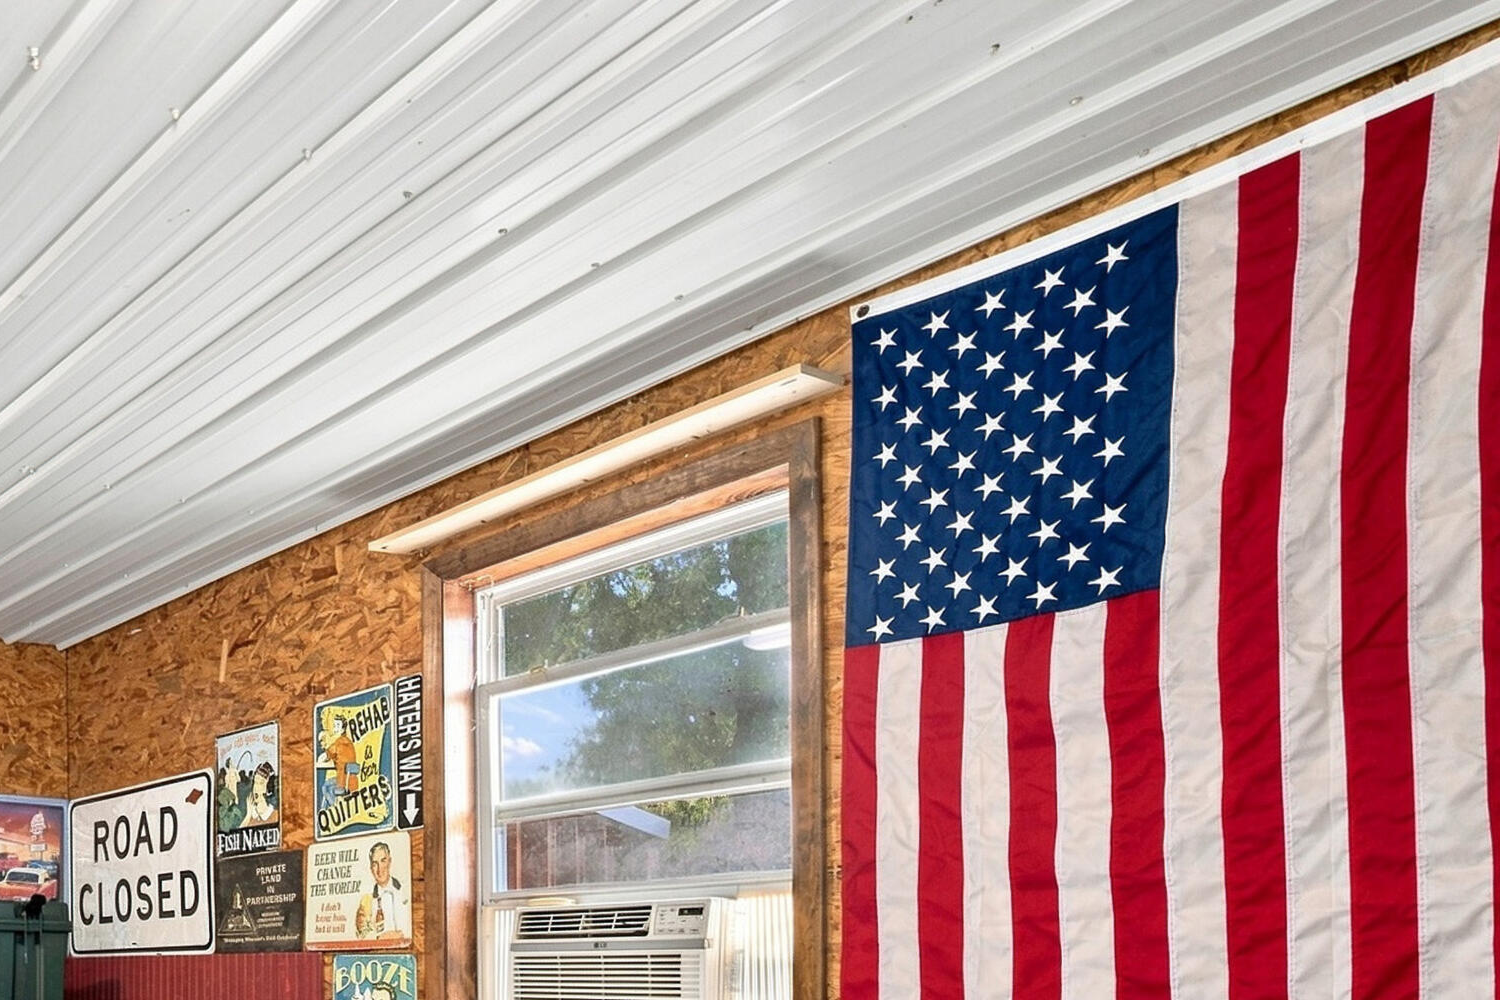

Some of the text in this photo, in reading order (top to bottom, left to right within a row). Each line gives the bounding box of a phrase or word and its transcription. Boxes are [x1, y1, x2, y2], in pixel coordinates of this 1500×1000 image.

[349, 696, 391, 743] REHAB
[398, 676, 422, 792] HATER'S WAY
[364, 745, 373, 760] is
[360, 762, 379, 782] for
[317, 775, 391, 833] QUITTERS
[93, 806, 179, 863] ROAD
[216, 827, 280, 857] FISH NAKED
[314, 848, 359, 867] BEER WILL
[255, 864, 287, 876] PRIVATE
[261, 874, 282, 885] LAND
[316, 865, 352, 881] CHANGE
[79, 869, 200, 926] CLOSED
[246, 893, 297, 905] PARTNERSHIP
[266, 885, 275, 894] IN
[310, 882, 327, 897] THE
[335, 960, 413, 997] BOOZE
